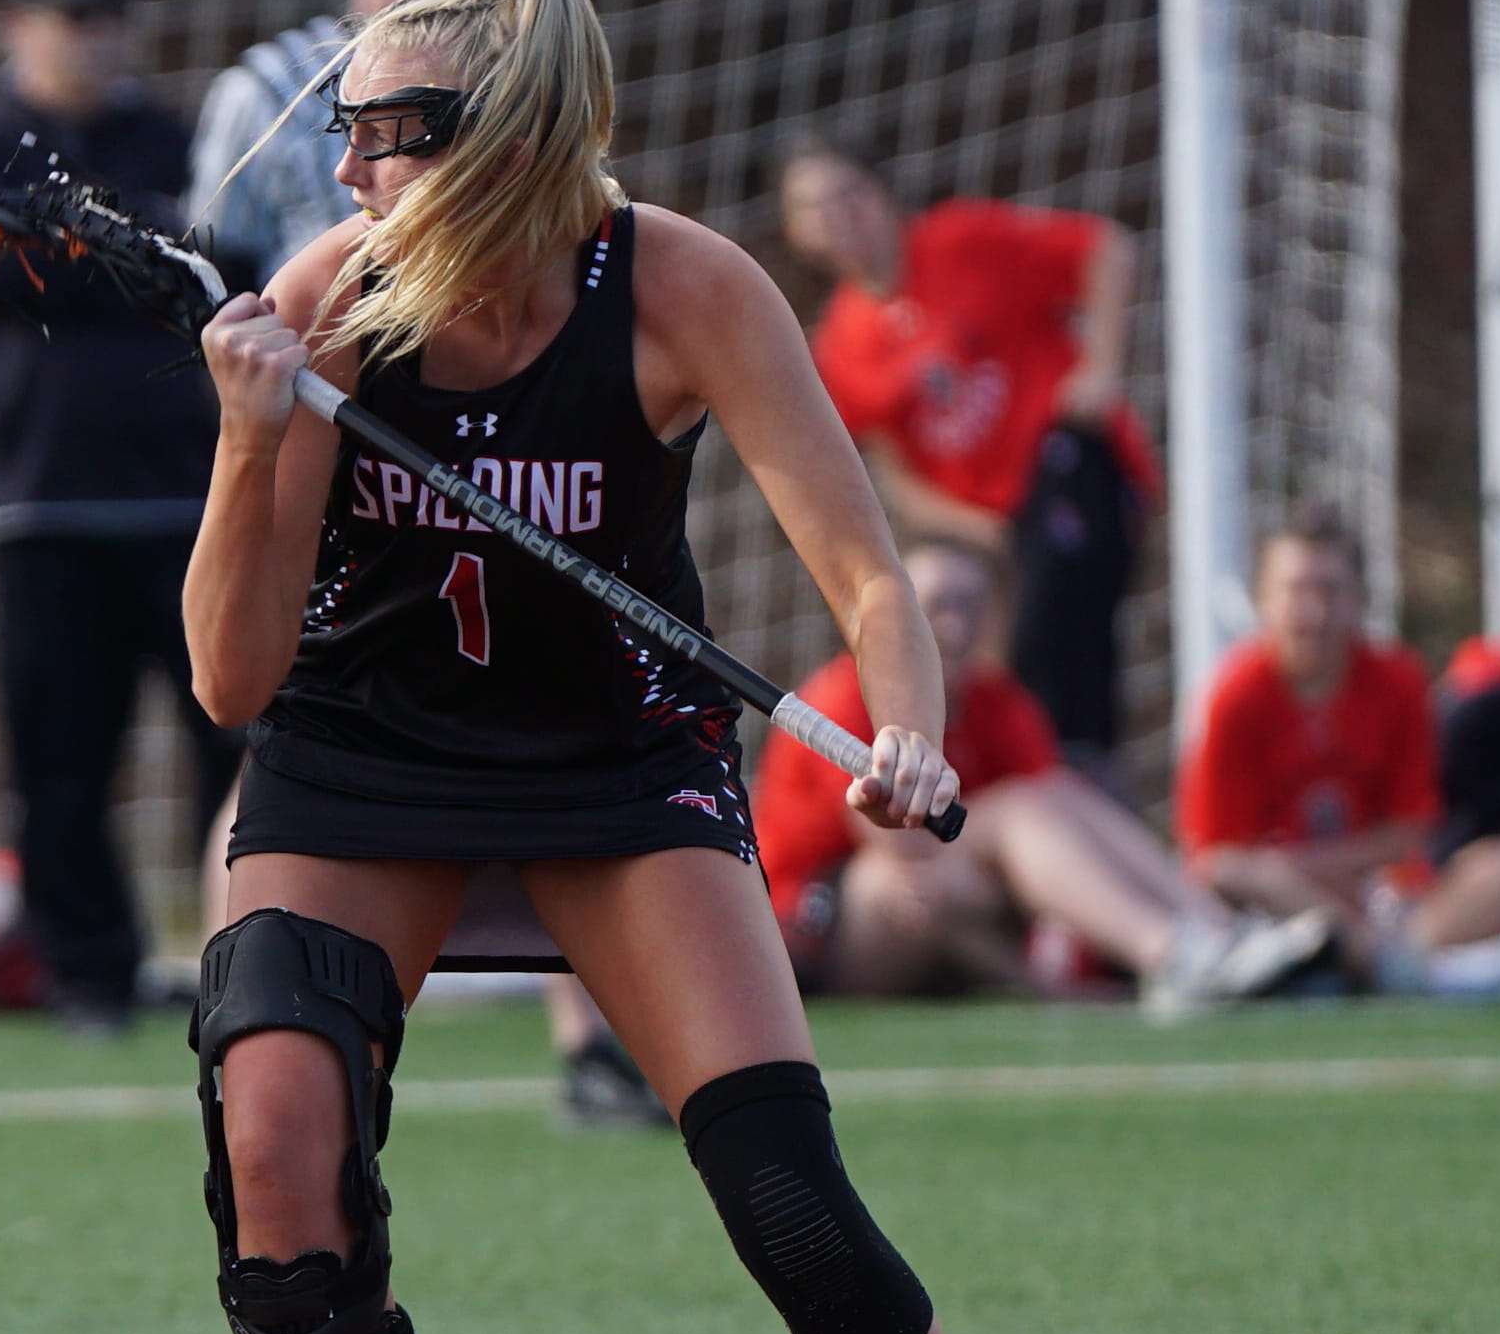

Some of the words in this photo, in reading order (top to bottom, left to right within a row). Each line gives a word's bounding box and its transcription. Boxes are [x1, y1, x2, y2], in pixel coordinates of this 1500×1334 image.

[426, 462, 581, 571] ARMOUR
[438, 551, 491, 666] 1
[580, 567, 702, 662] UNDER
